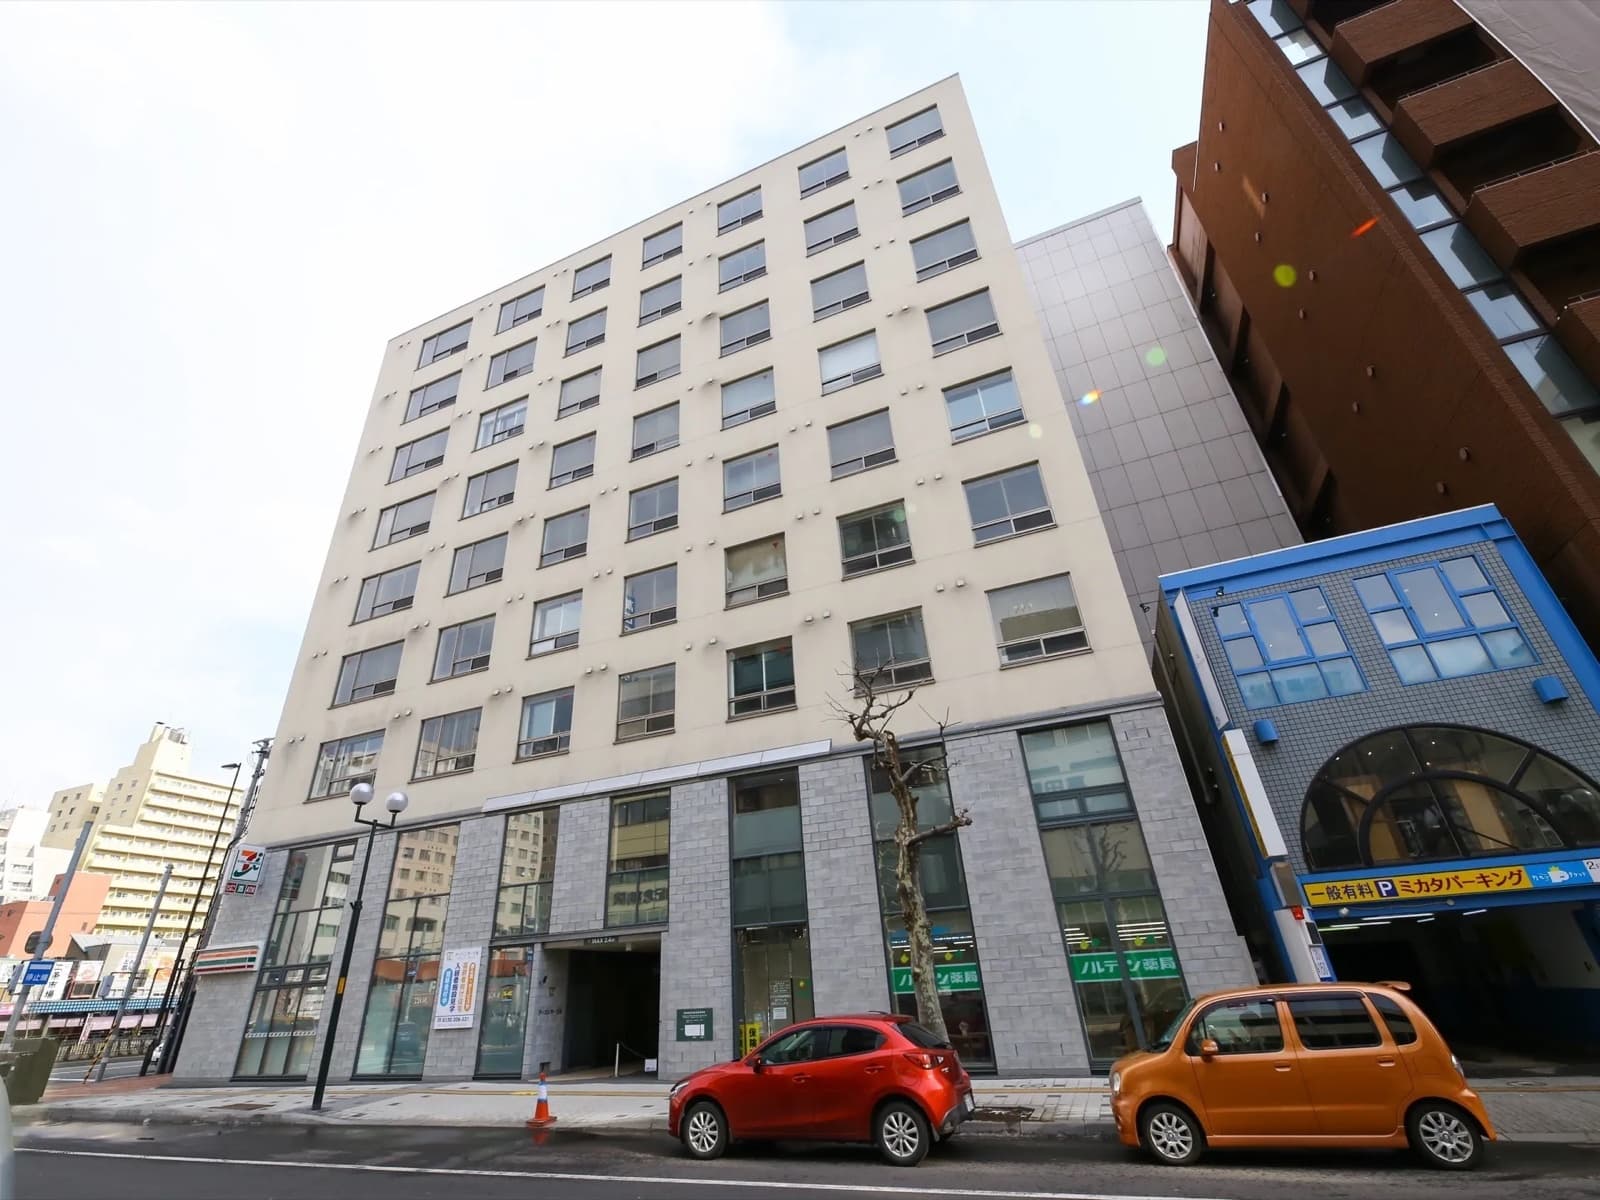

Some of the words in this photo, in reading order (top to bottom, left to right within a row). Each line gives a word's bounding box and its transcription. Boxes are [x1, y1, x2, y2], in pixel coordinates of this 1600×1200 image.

[1311, 882, 1374, 900] 一般有料
[1377, 881, 1393, 896] P
[1399, 869, 1523, 893] ミカタパーキング
[899, 970, 978, 987] ノン薬局
[748, 1027, 758, 1050] 保険
